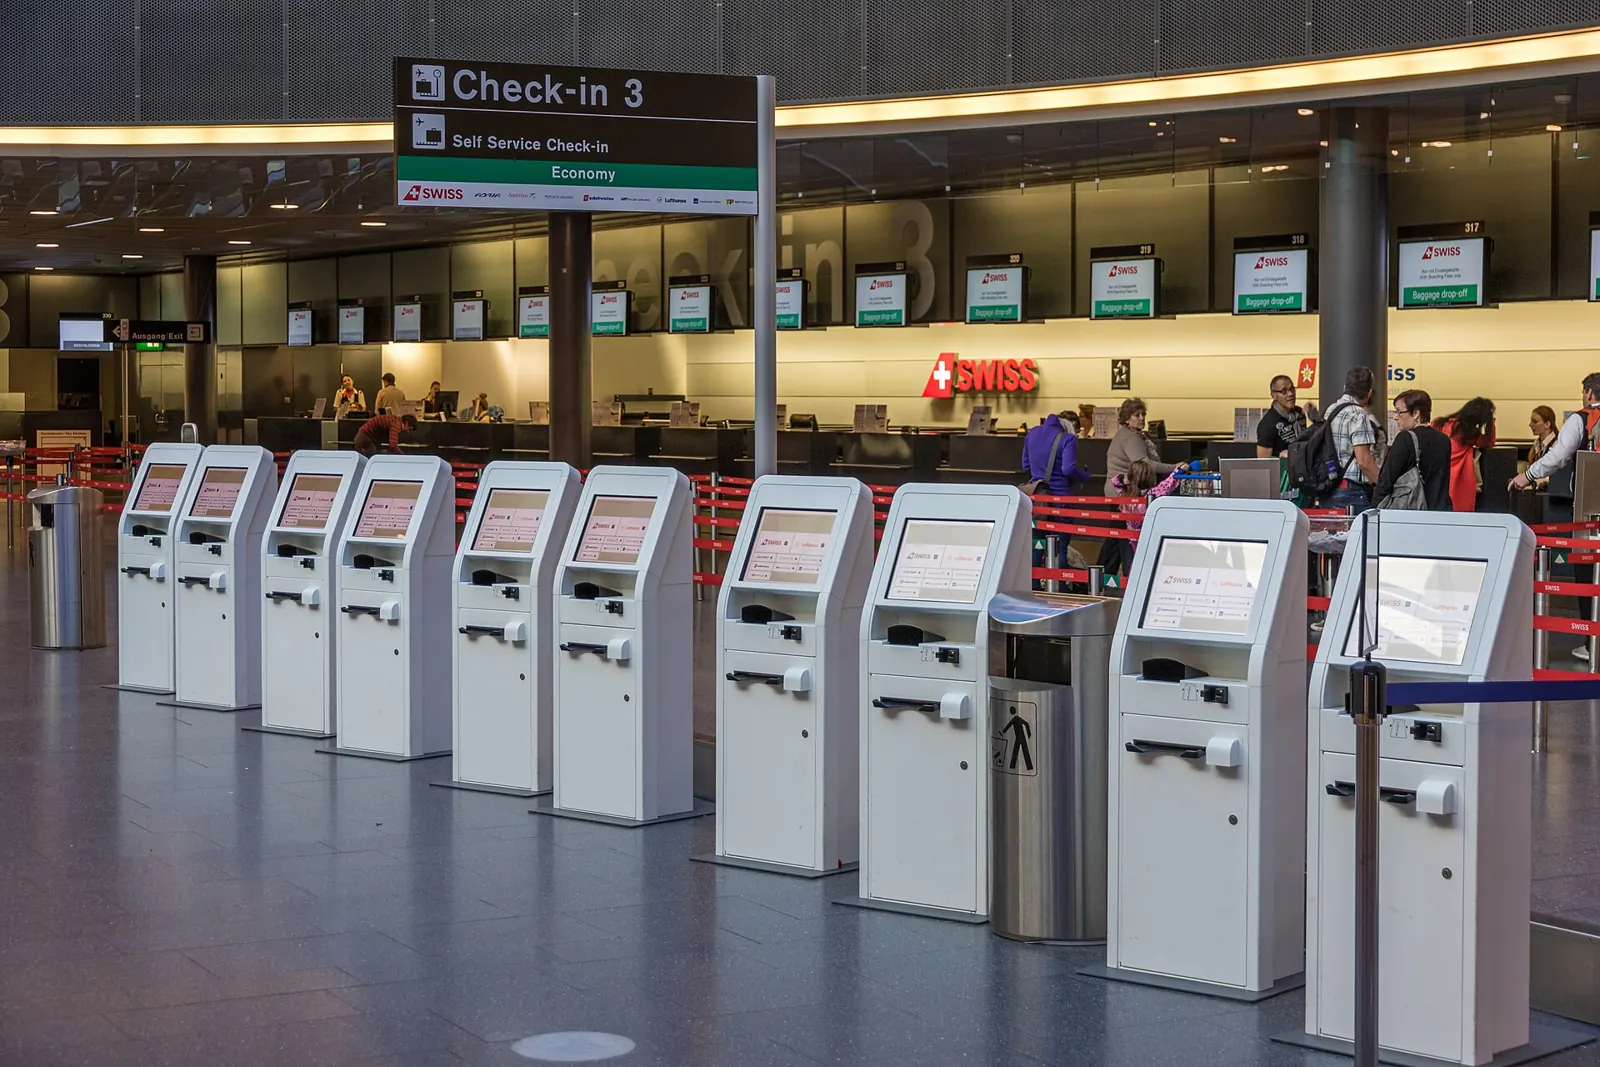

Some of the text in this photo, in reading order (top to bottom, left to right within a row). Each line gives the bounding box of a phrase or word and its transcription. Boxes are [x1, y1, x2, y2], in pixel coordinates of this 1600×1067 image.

[453, 68, 644, 108] Check-in 3
[452, 133, 609, 153] Self Service Check-in
[552, 165, 616, 183] Economy
[422, 188, 464, 200] SWISS
[1465, 222, 1480, 233] 317
[1292, 235, 1304, 244] 318
[1140, 246, 1152, 254] 319
[1434, 246, 1461, 257] SWISS
[1010, 255, 1020, 263] 320
[1265, 257, 1288, 266] SWISS
[1118, 266, 1138, 275] SWISS
[990, 274, 1008, 282] SWISS
[1412, 288, 1468, 301] Baggage drop-off
[1246, 296, 1294, 307] Baggage drop-off
[1101, 302, 1143, 313] Baggage drop-off
[957, 358, 1037, 392] SWISS
[1380, 598, 1401, 608] SWISS
[1571, 622, 1589, 631] SWISS
